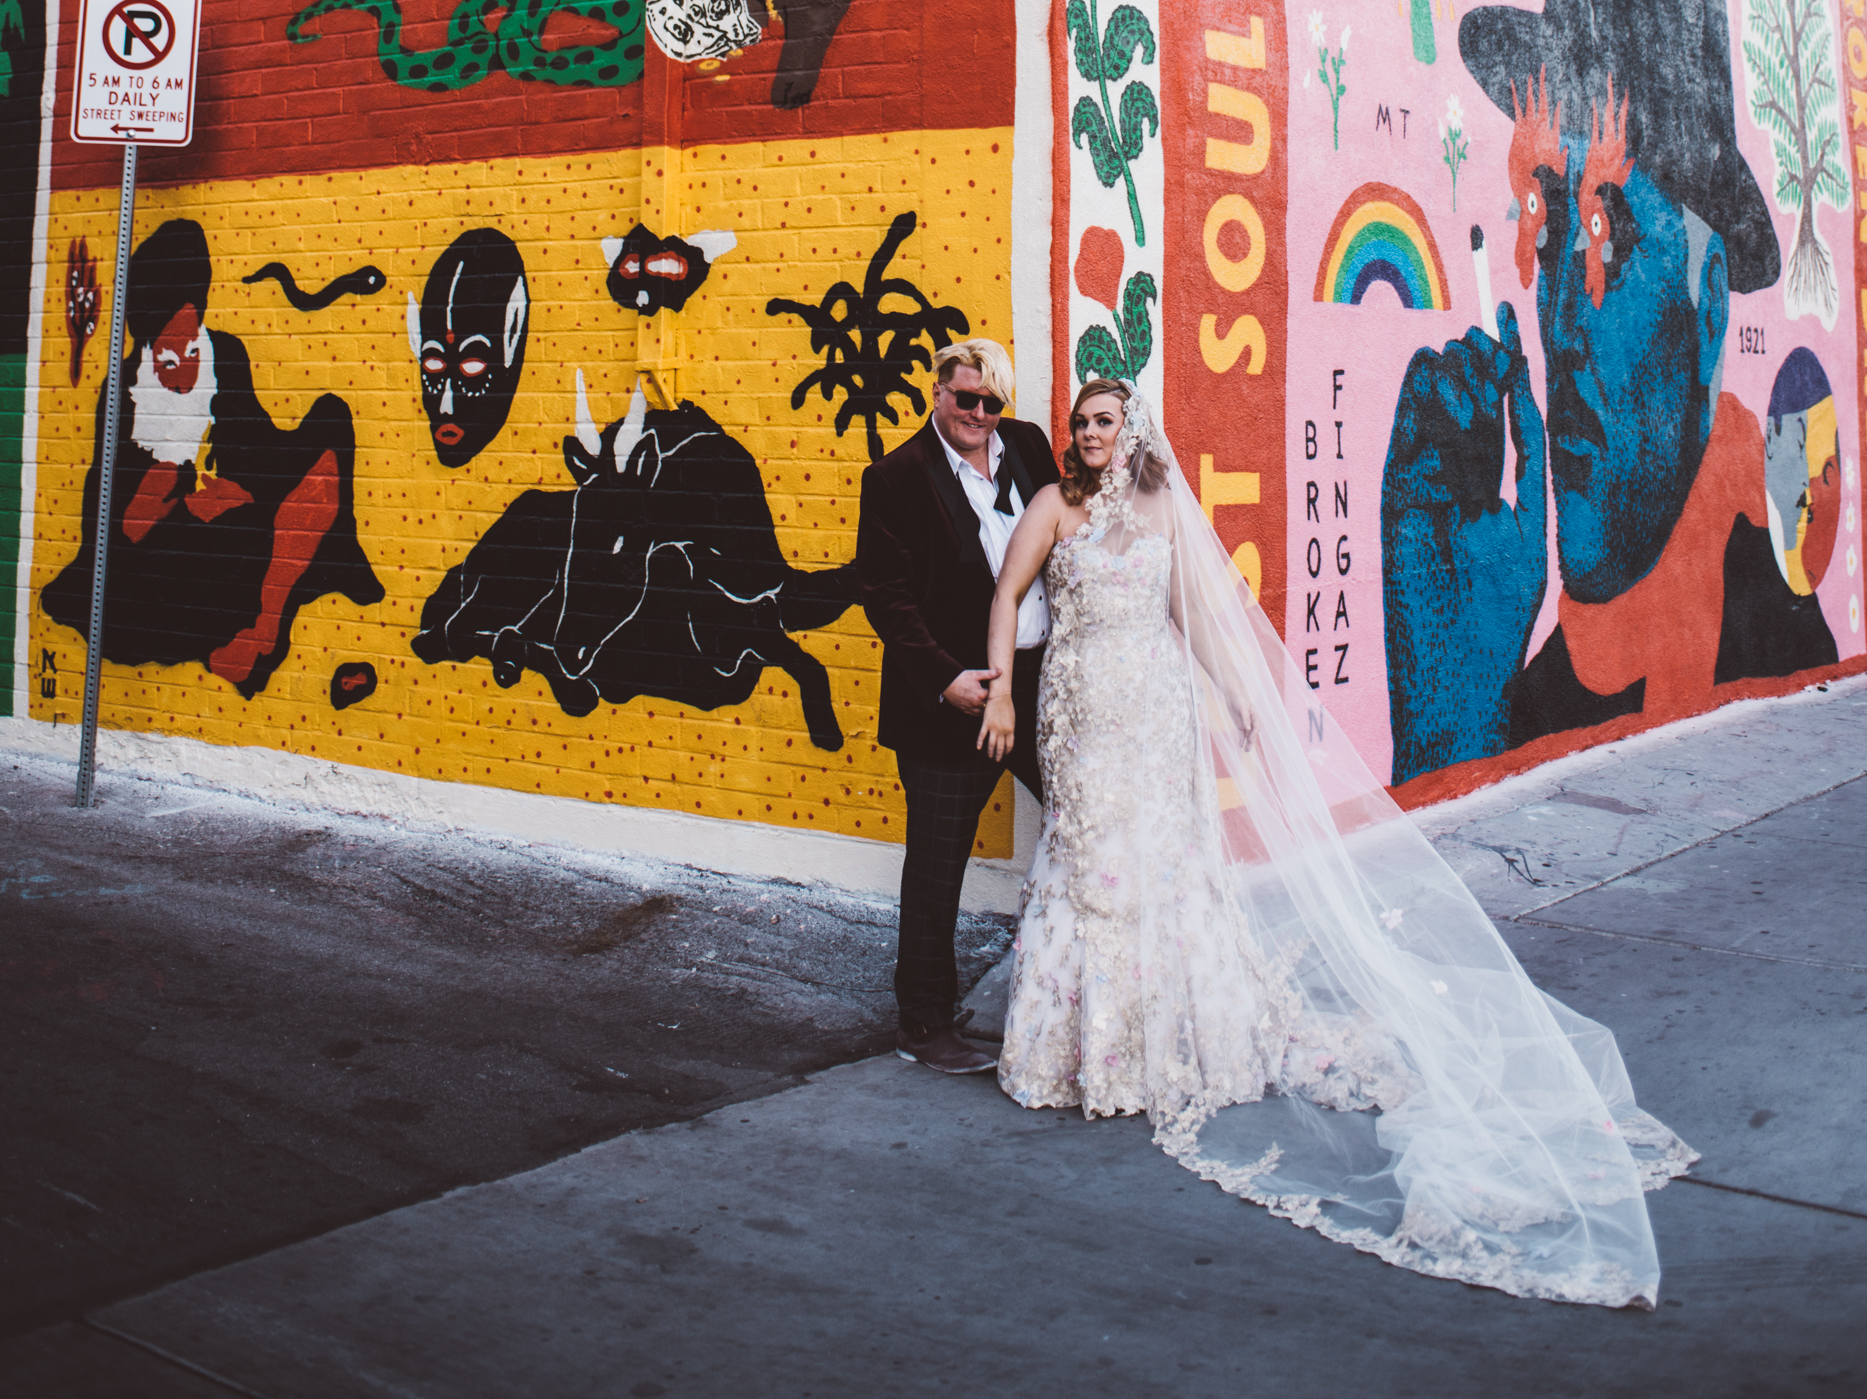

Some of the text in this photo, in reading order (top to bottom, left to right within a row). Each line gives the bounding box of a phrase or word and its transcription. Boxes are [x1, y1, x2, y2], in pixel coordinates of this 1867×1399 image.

[89, 73, 183, 90] 5 AM TO 6 AM
[109, 91, 160, 107] DAILY
[82, 108, 184, 123] STREET SWEEPING
[1739, 326, 1766, 354] 1921
[1333, 369, 1351, 685] FINGAZ
[1305, 420, 1325, 743] BROKEN
